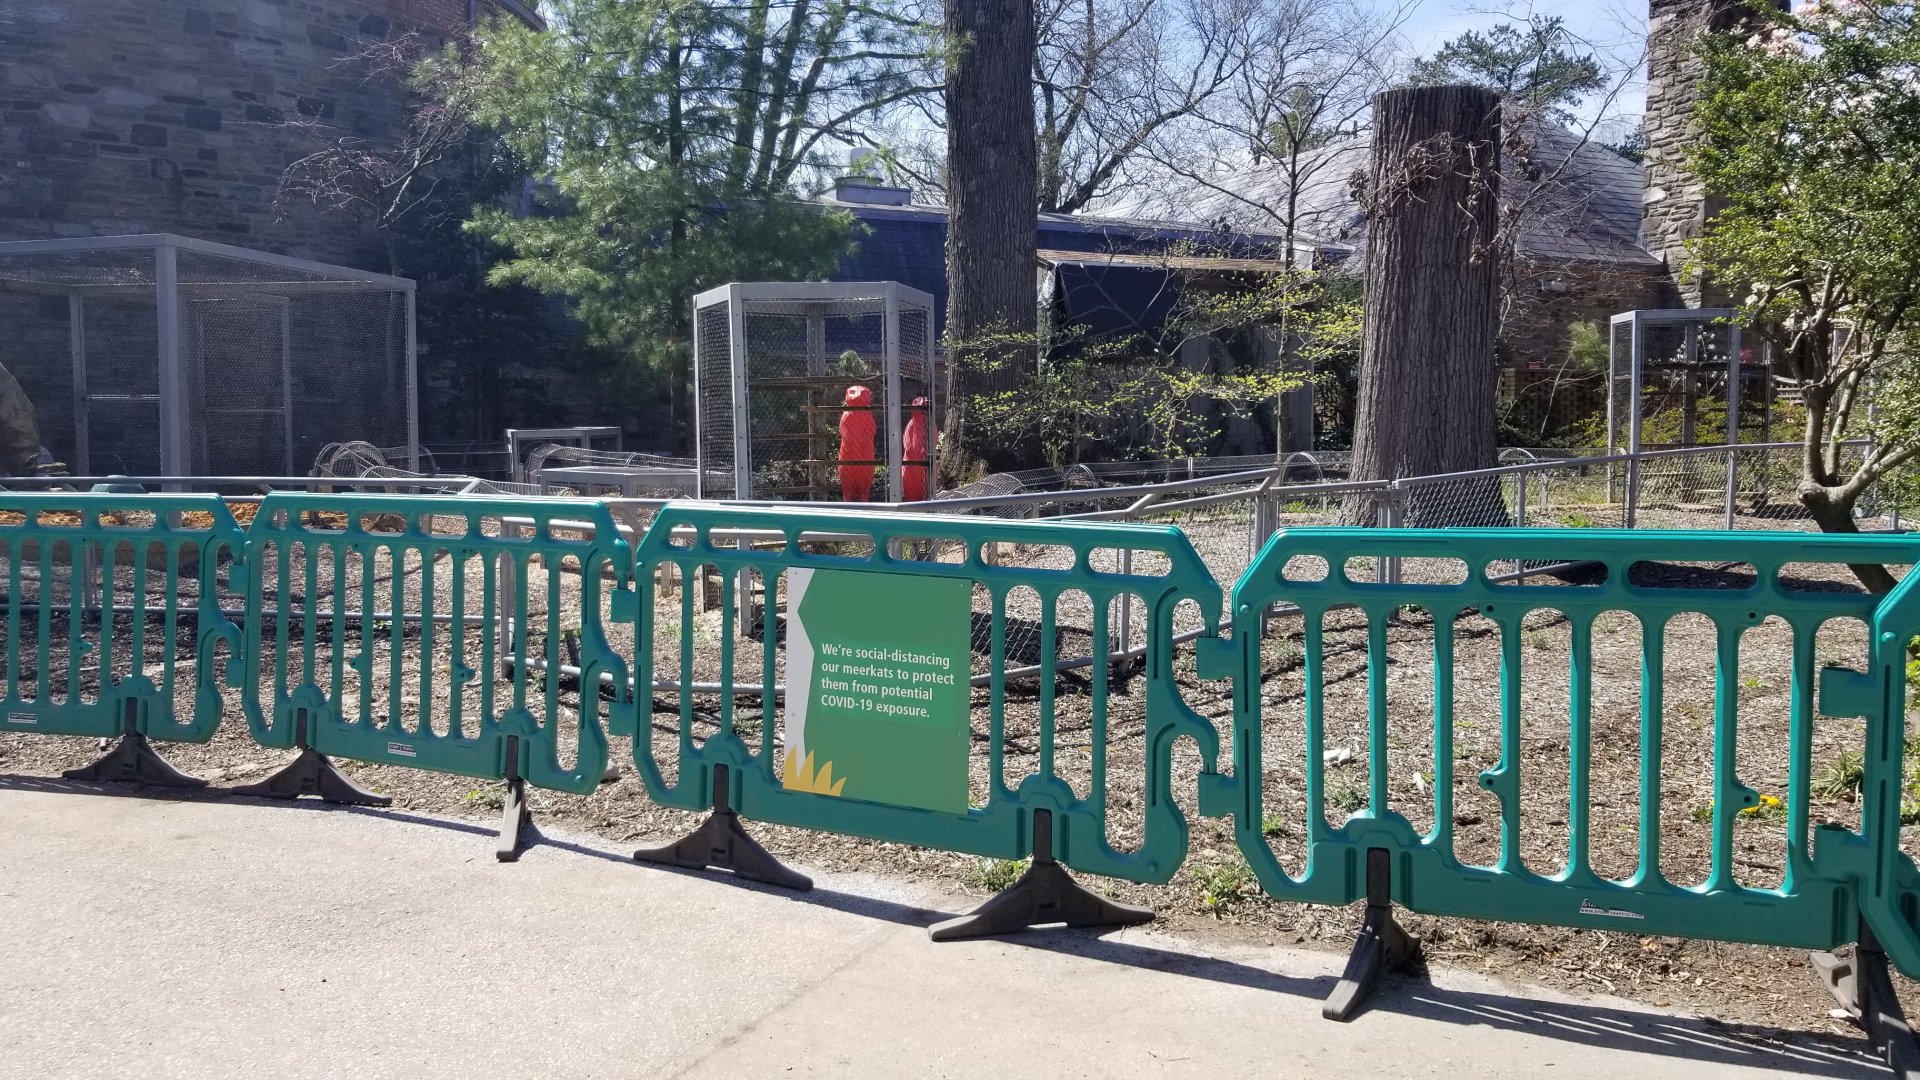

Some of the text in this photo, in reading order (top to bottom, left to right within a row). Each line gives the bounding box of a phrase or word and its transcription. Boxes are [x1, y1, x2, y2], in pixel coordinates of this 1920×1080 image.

[822, 643, 950, 670] We're social-distancing
[822, 662, 955, 685] our meerkats to protect
[821, 677, 933, 700] them from potential
[821, 694, 930, 718] COVID-19 exposure.
